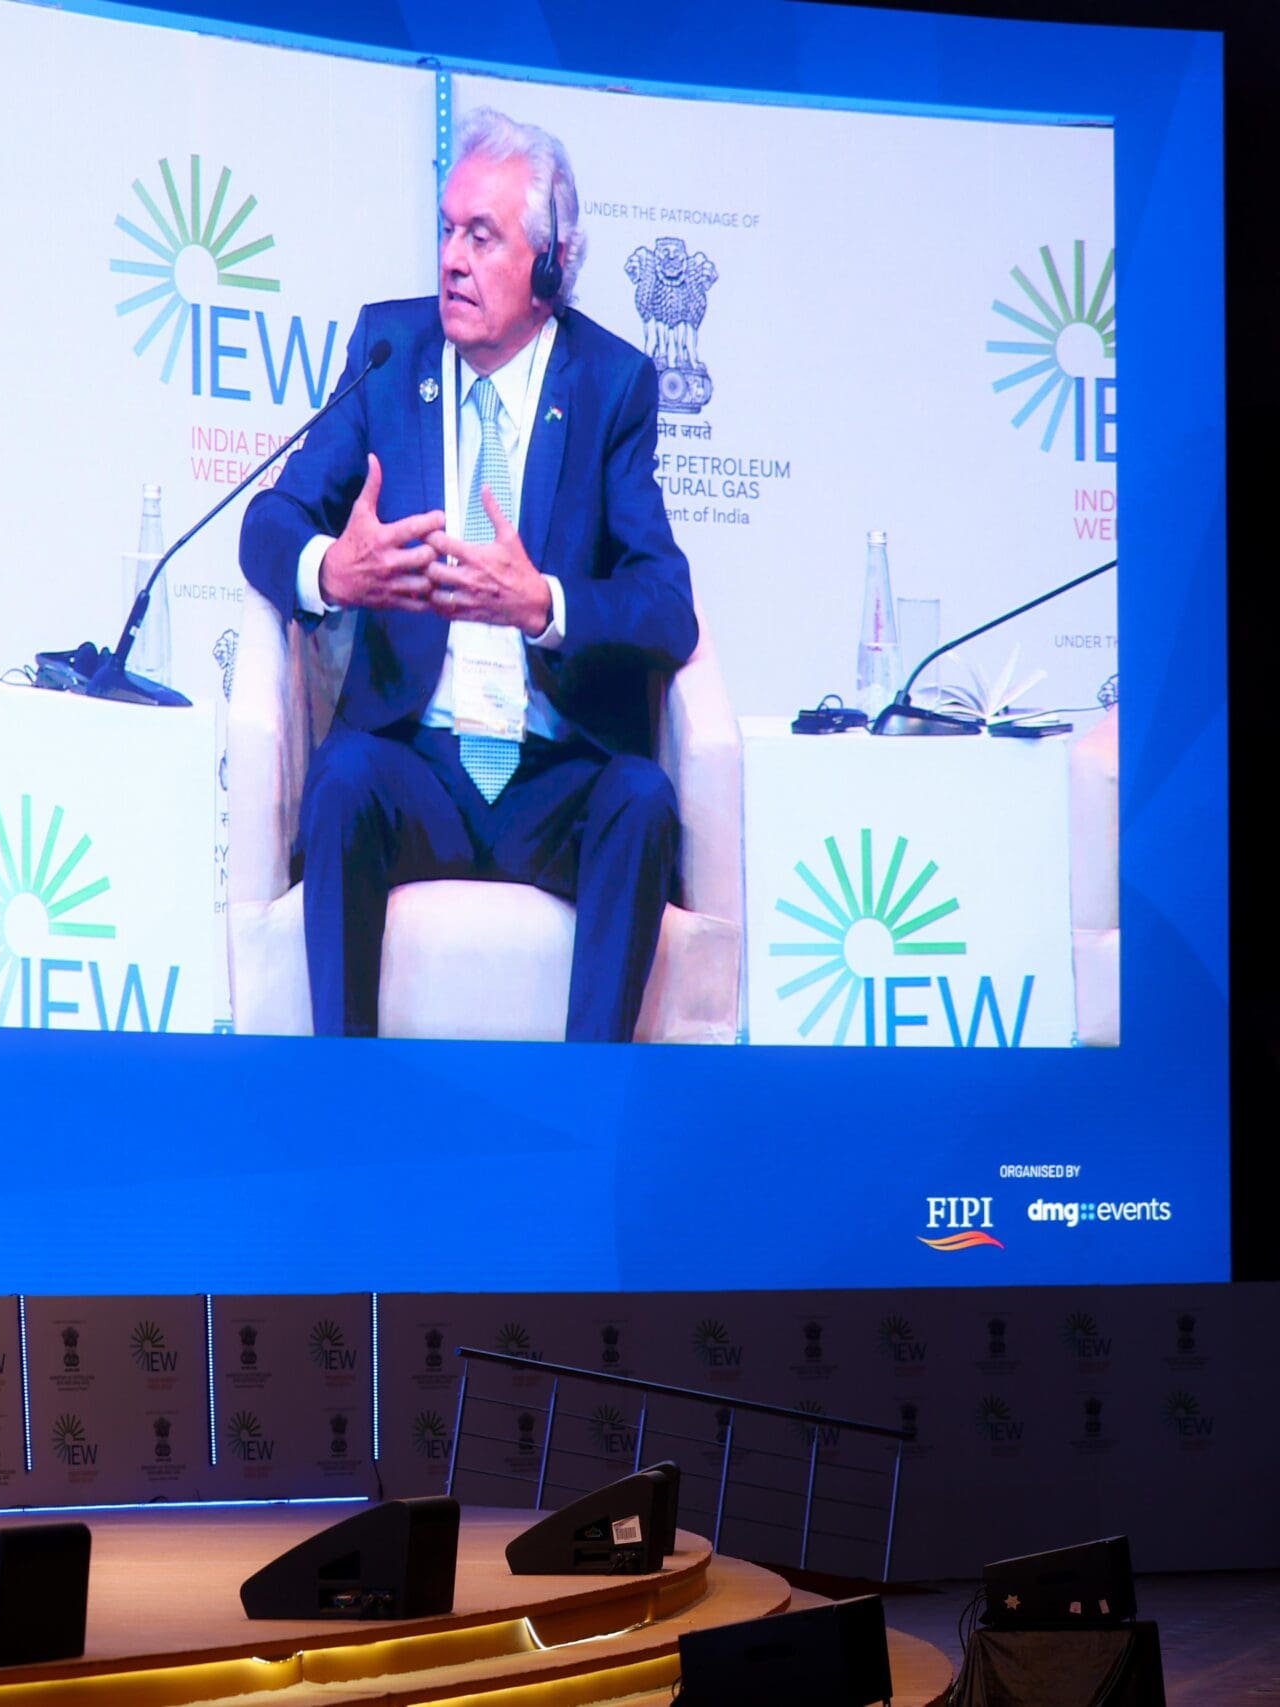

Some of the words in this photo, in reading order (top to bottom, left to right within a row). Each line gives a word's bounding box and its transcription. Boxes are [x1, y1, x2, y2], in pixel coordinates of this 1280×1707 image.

[584, 200, 628, 218] UNDER
[632, 205, 656, 221] THE
[660, 207, 739, 228] PATRONAGE
[742, 214, 760, 228] OF
[191, 303, 338, 409] IEW
[191, 426, 250, 455] INDIA
[677, 455, 790, 479] PETROLEUM
[722, 480, 760, 499] GAS
[693, 506, 709, 523] of
[713, 508, 750, 524] India
[174, 584, 217, 600] UNDER
[219, 586, 244, 602] THE
[1054, 634, 1102, 649] UNDER
[999, 1165, 1063, 1179] ORGANISED
[1065, 1165, 1081, 1178] BY
[926, 1197, 993, 1228] FIPI
